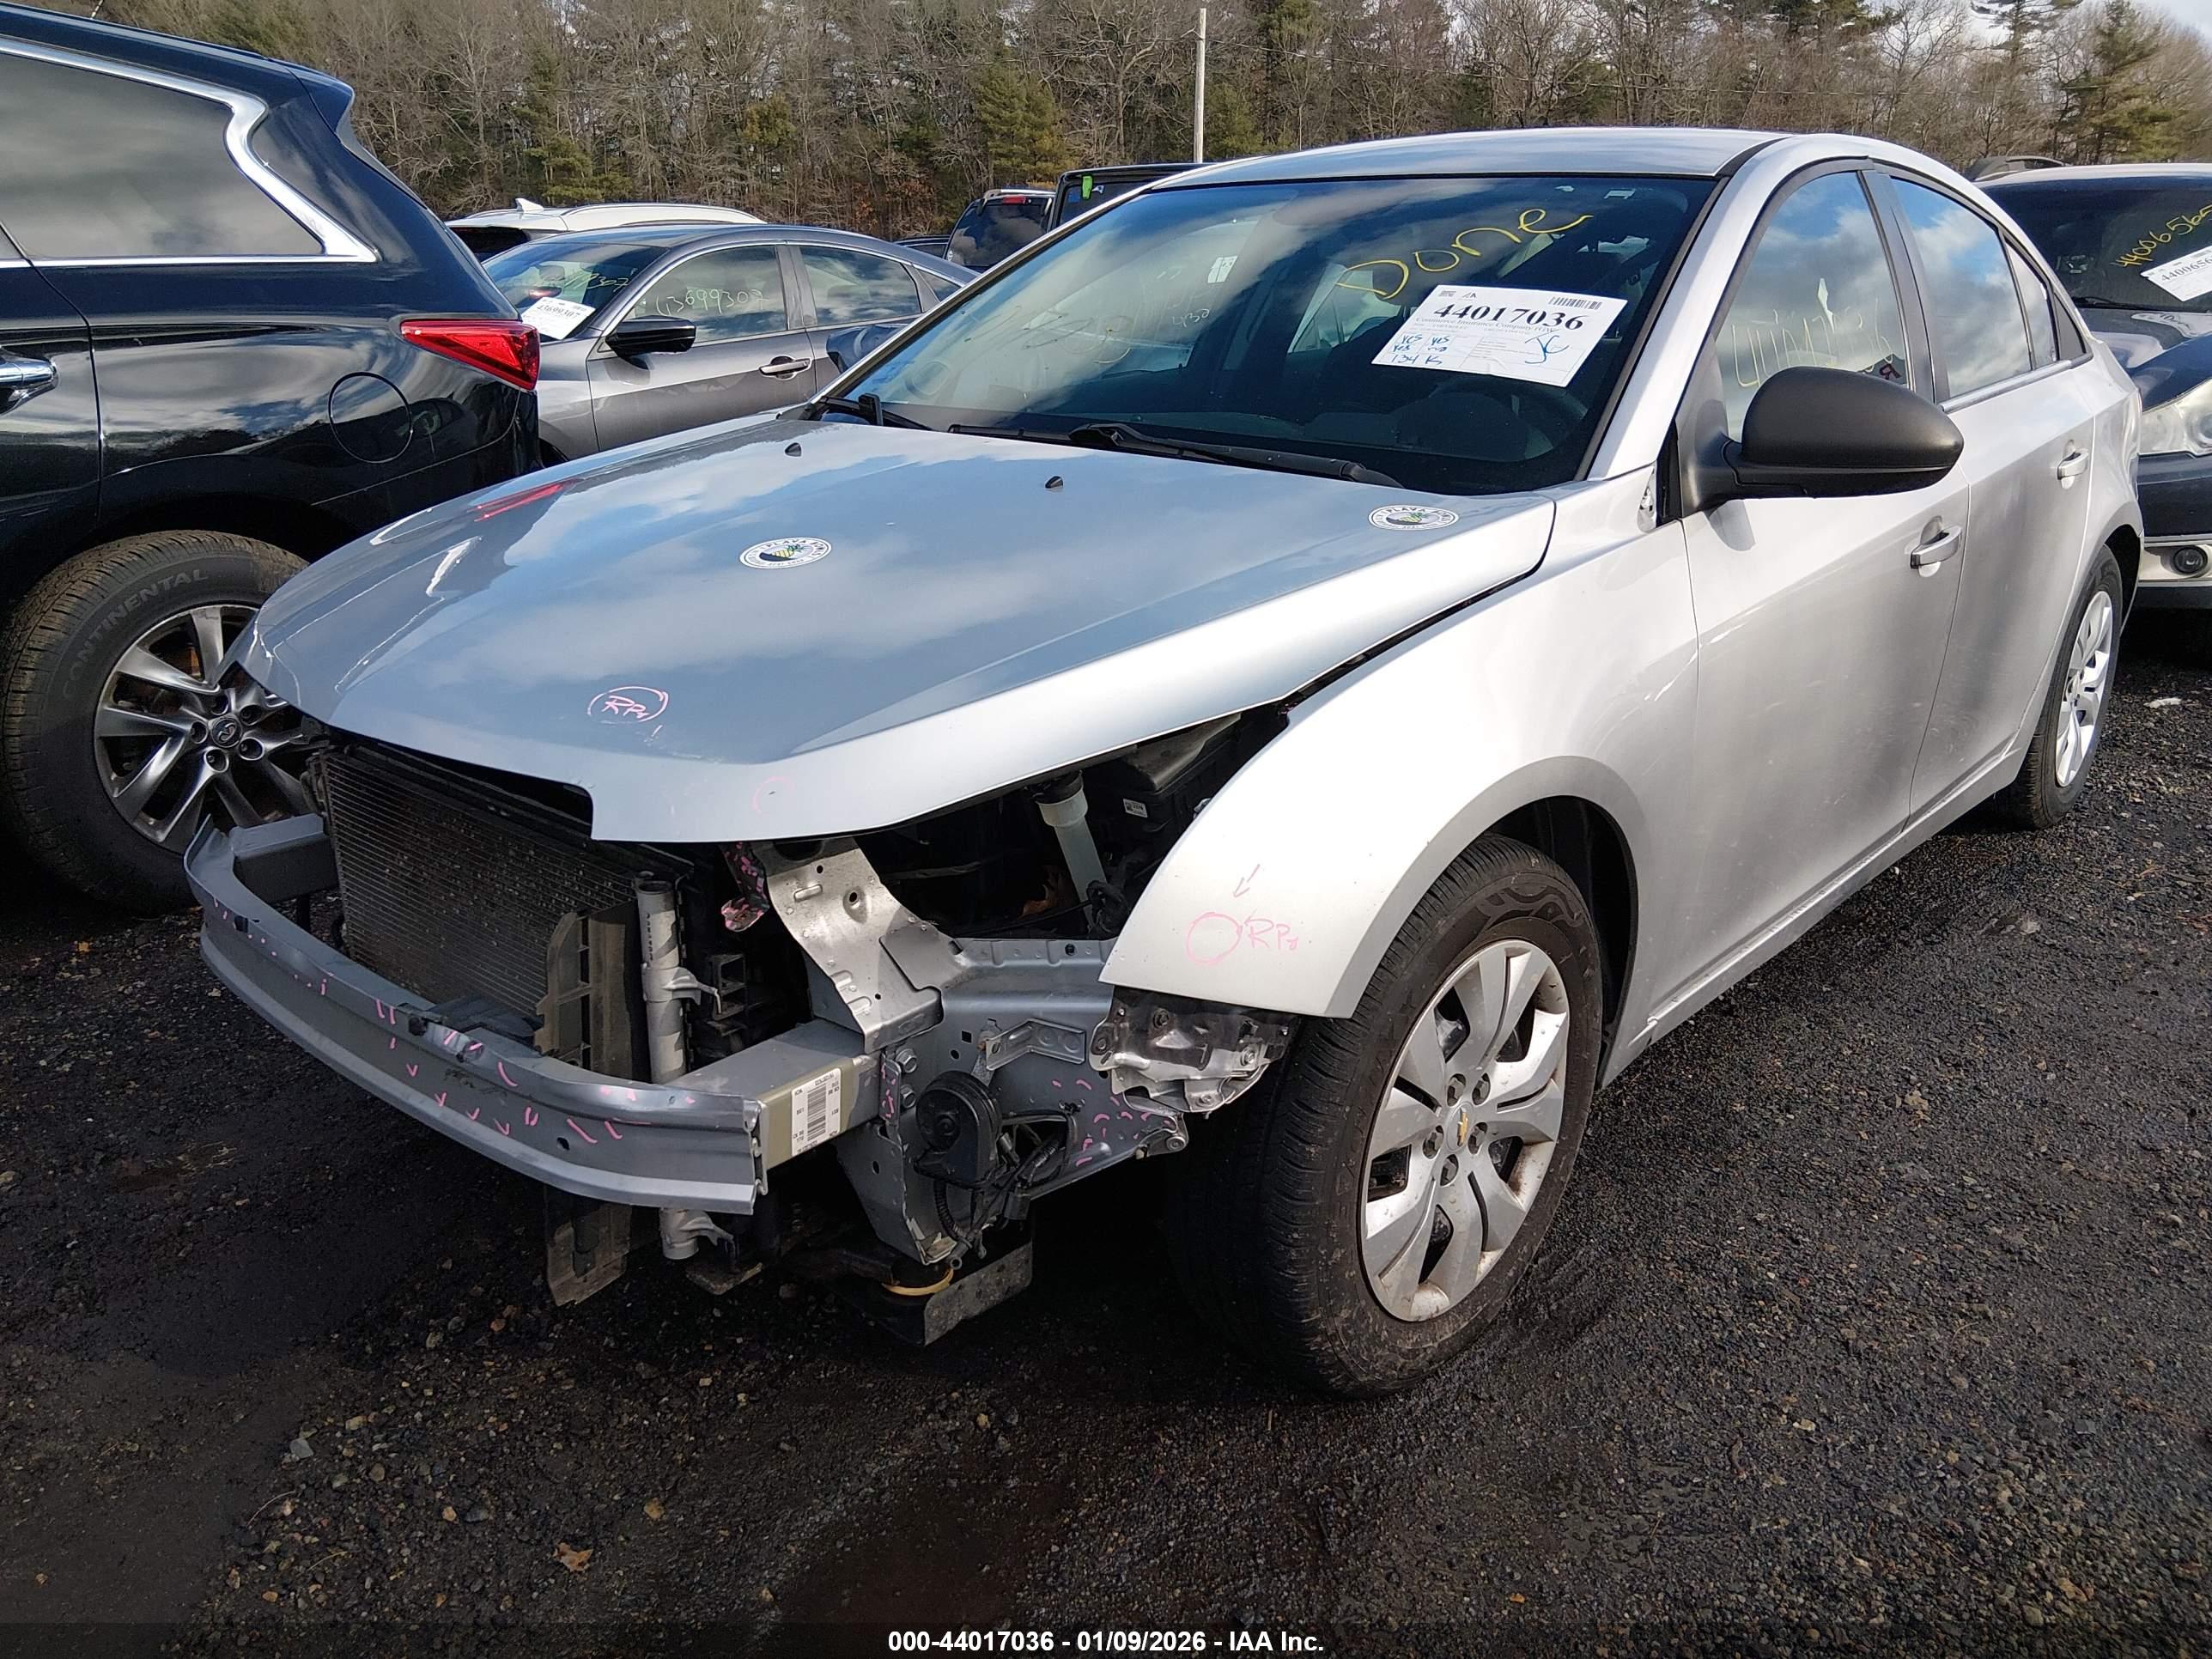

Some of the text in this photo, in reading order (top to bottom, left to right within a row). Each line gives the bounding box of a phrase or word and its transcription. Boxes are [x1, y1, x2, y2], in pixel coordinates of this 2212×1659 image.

[1333, 208, 1594, 301] Done
[1433, 302, 1589, 331] 44017036
[63, 568, 209, 701] CONTINENTAL
